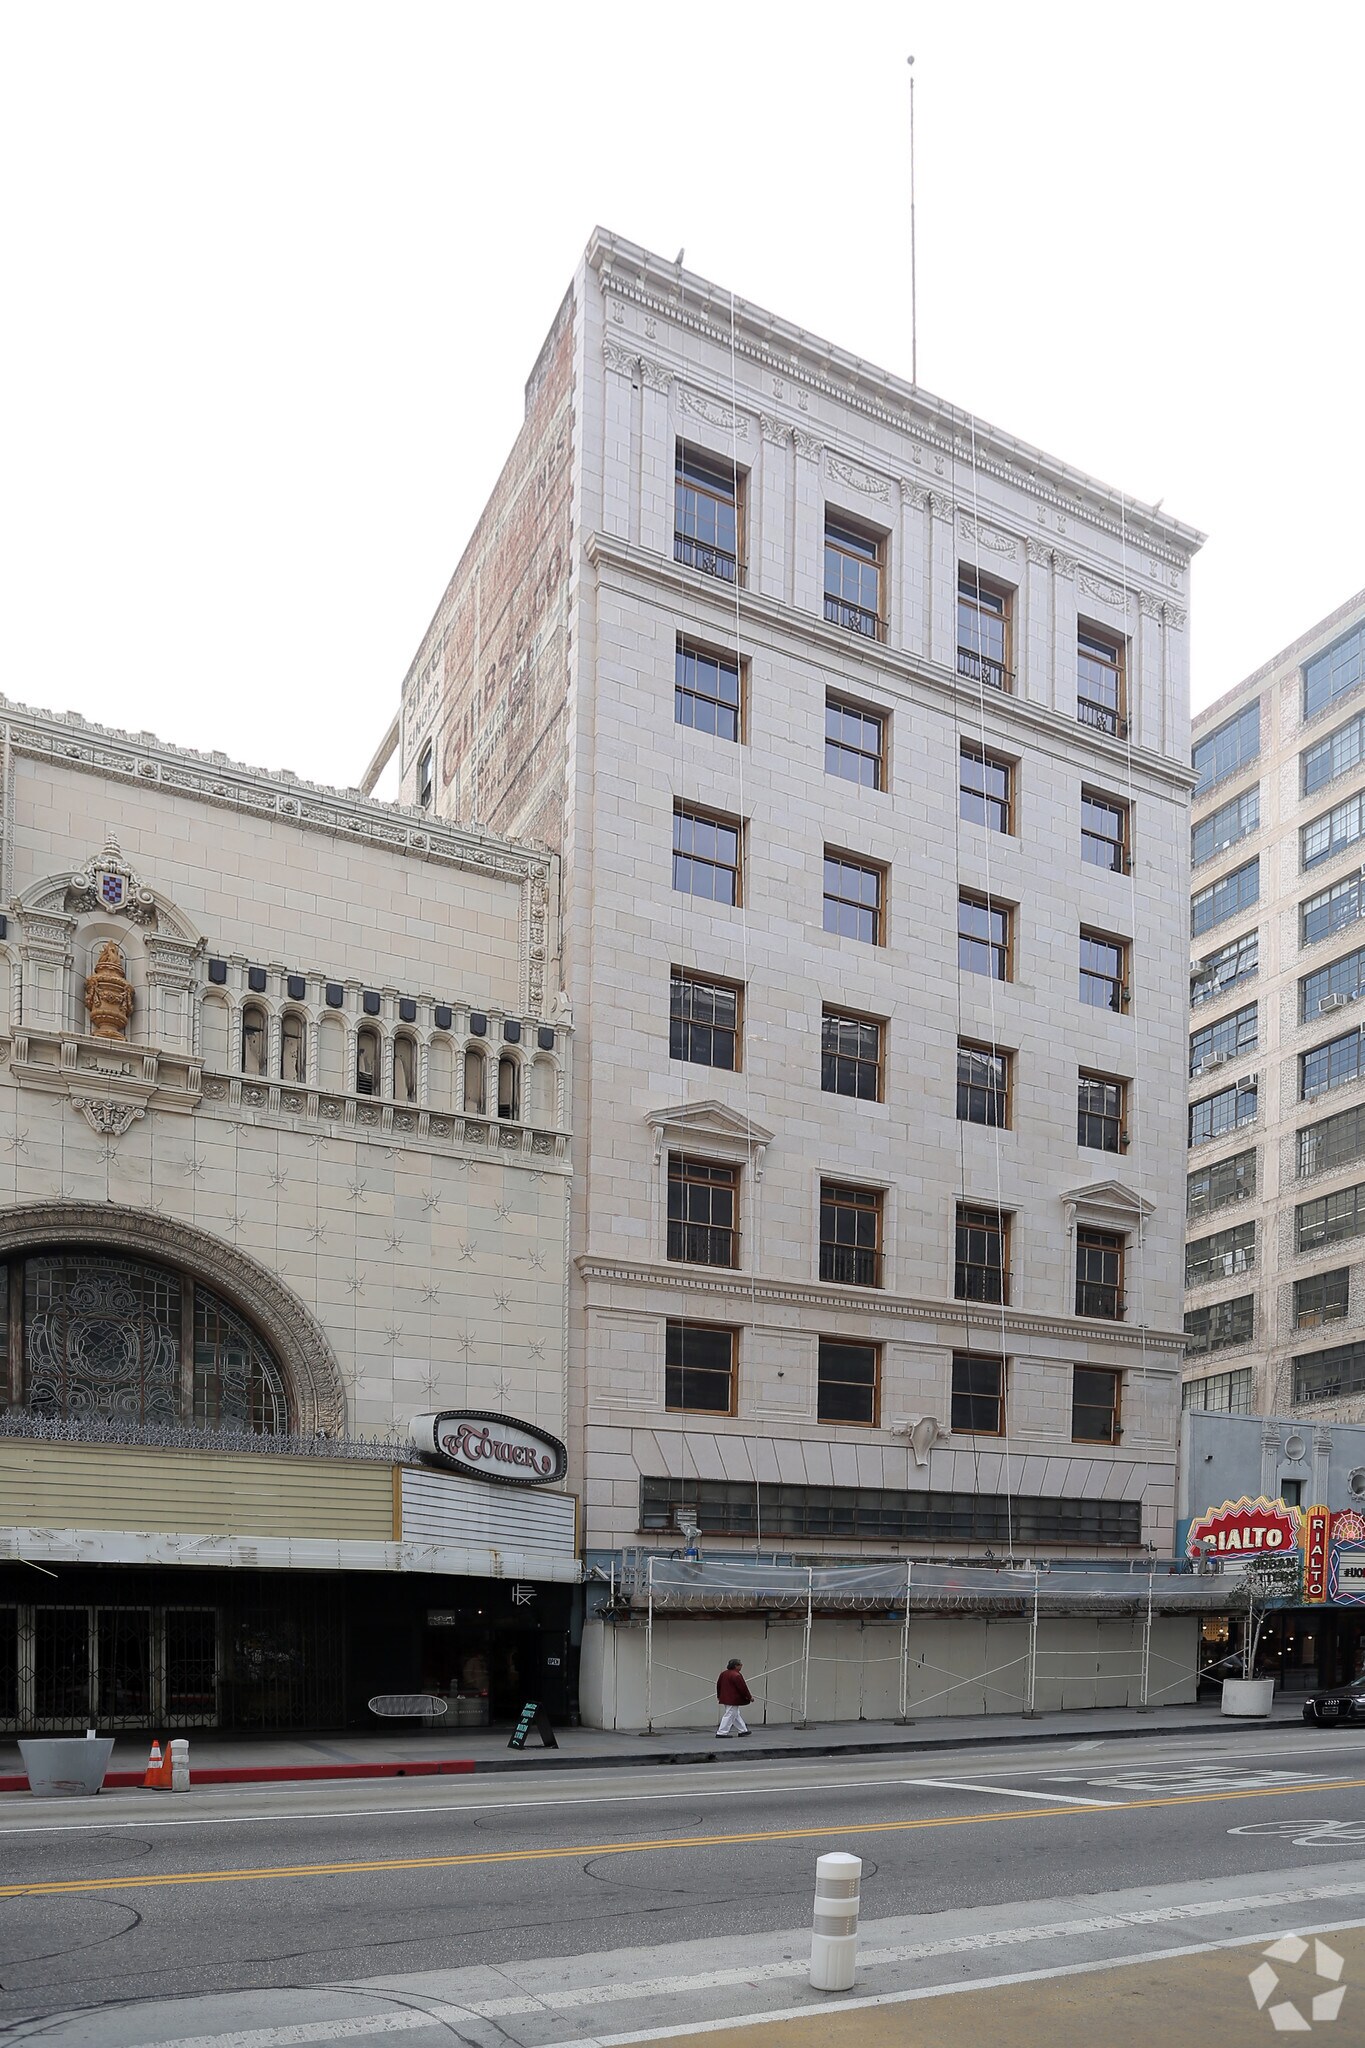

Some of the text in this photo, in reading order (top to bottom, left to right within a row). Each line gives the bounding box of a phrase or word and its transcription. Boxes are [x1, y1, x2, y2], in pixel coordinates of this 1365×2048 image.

[408, 682, 439, 748] SINGER
[1202, 1527, 1283, 1551] RIALTO
[1309, 1519, 1324, 1594] RIALTO
[1344, 1566, 1365, 1578] #UO
[1038, 1765, 1353, 1794] HERE
